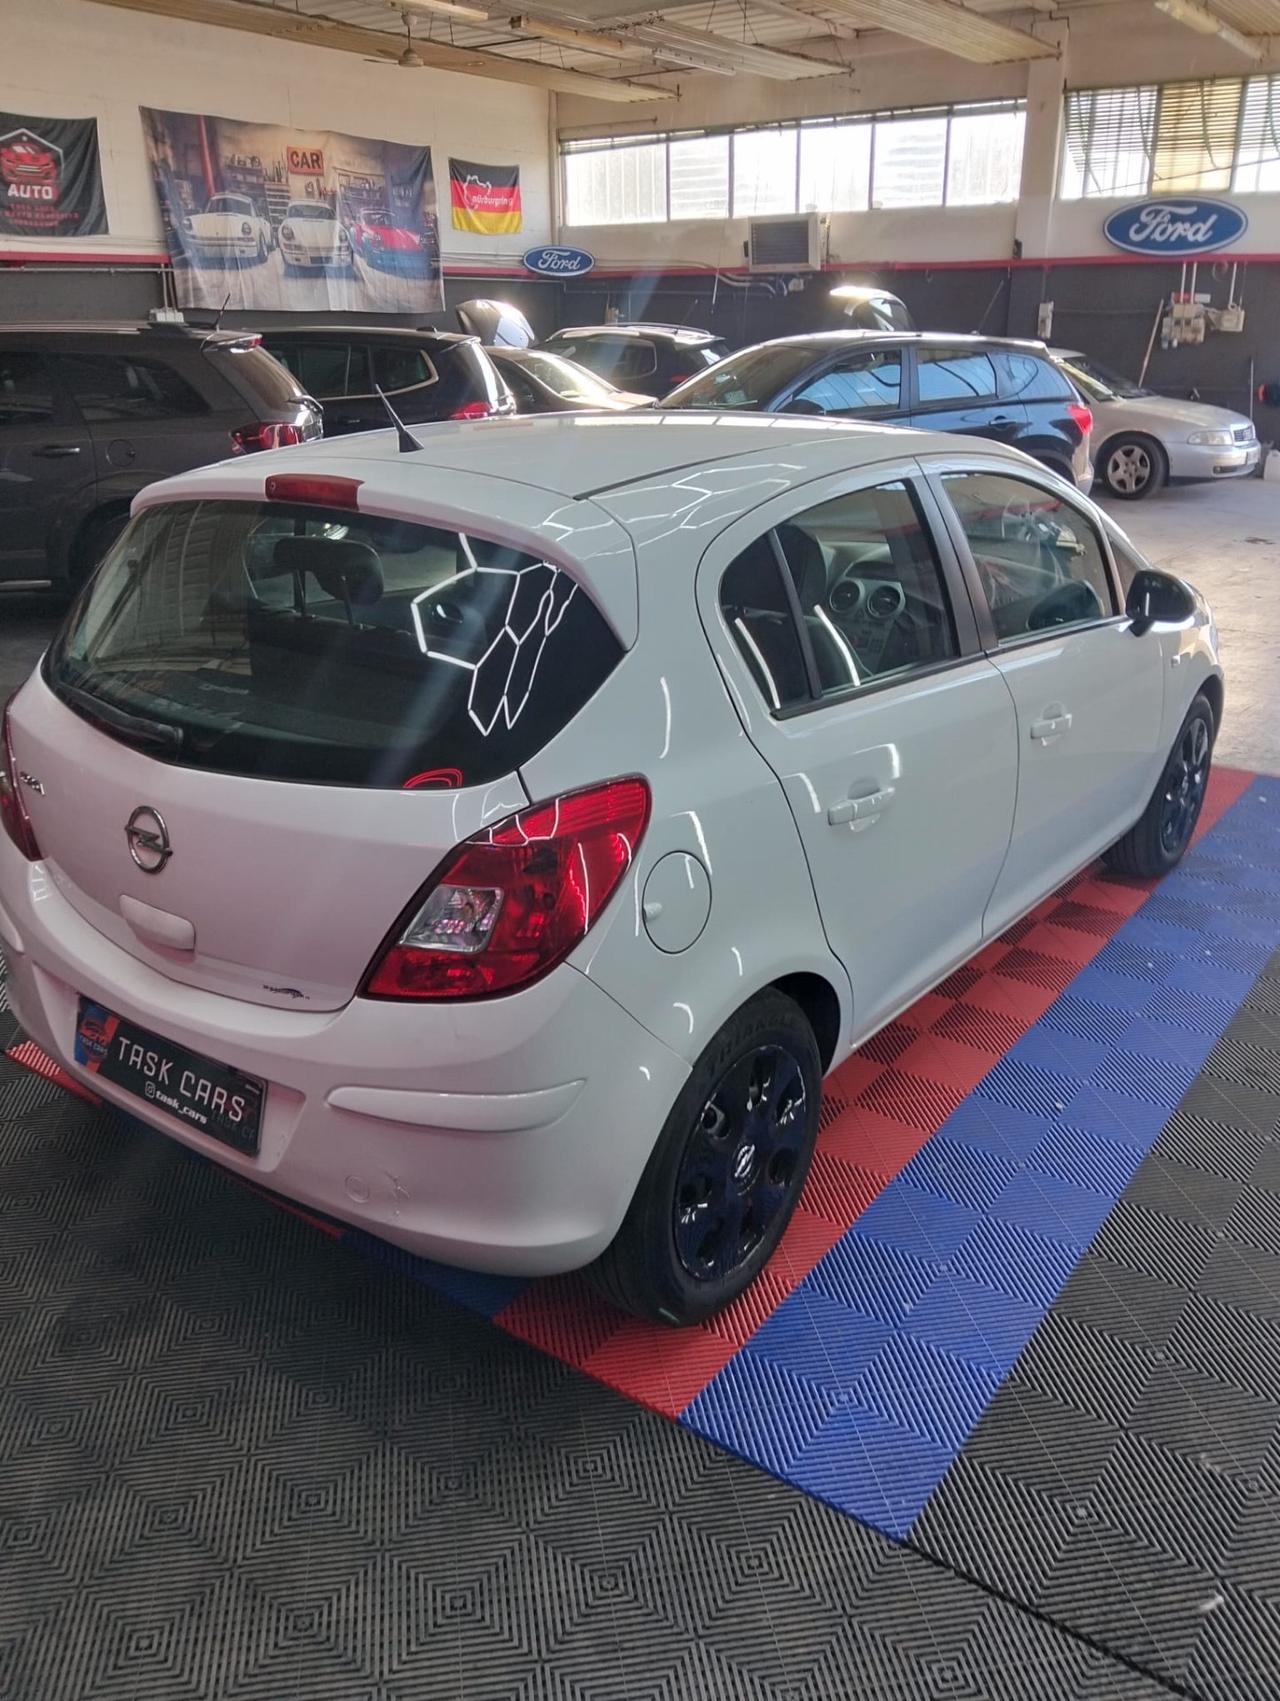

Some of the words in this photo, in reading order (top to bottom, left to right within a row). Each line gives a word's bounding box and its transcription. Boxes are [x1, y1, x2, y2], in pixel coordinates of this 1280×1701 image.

[290, 150, 322, 169] CAR
[7, 183, 53, 200] AUTO
[1129, 204, 1218, 242] Ford
[538, 249, 581, 270] Ford
[119, 1036, 174, 1085] TASK
[180, 1070, 245, 1122] CARS
[155, 1090, 208, 1124] task_cars
